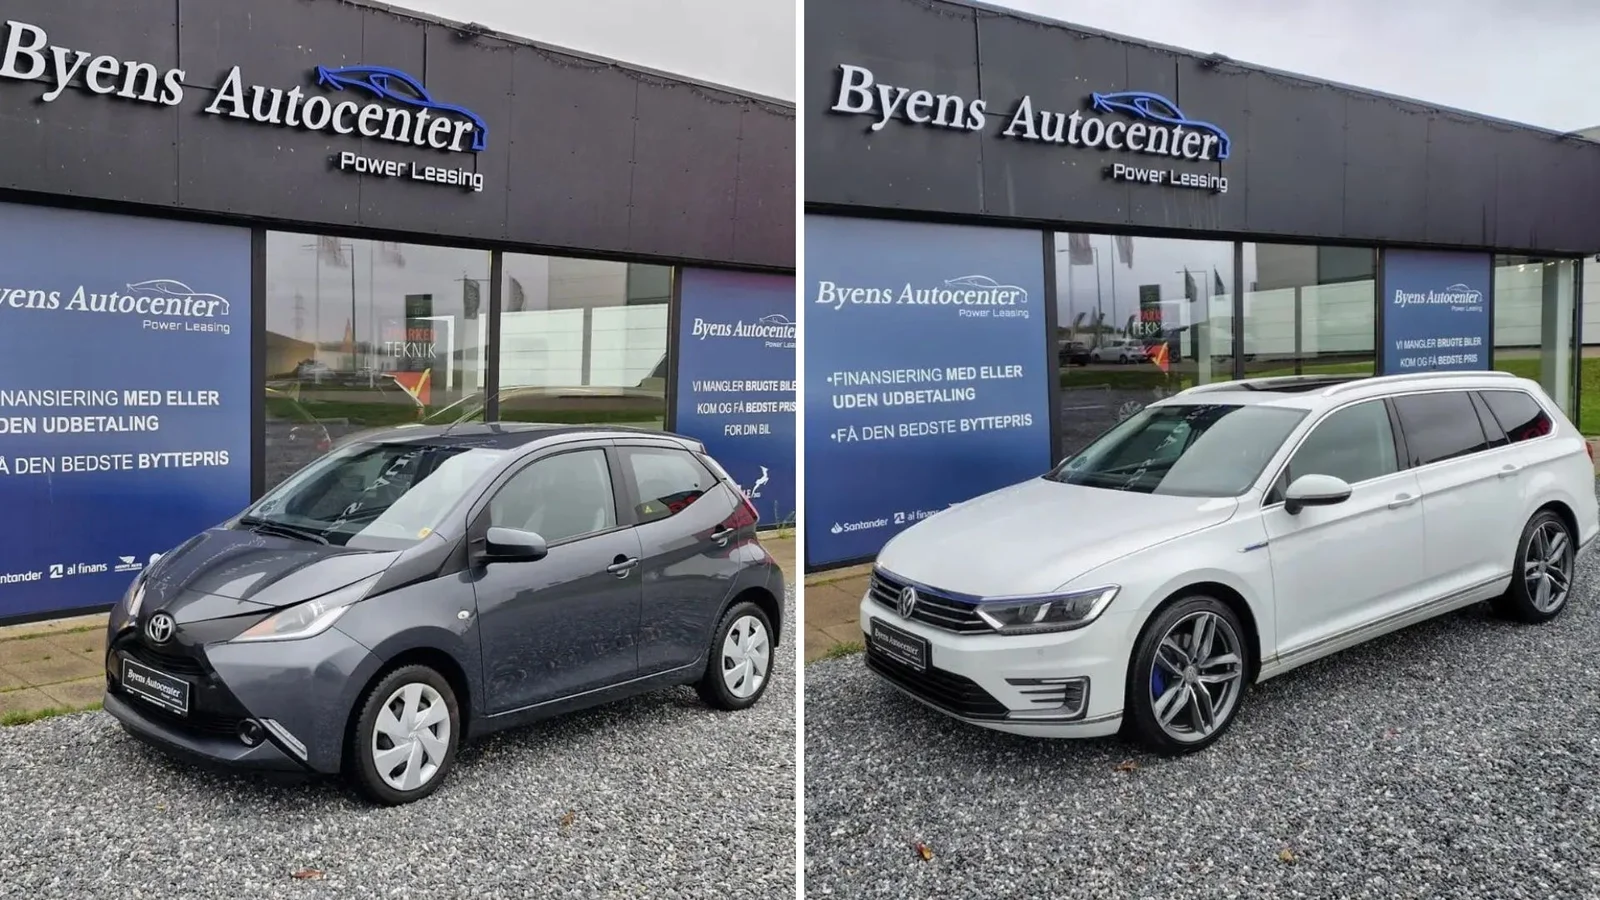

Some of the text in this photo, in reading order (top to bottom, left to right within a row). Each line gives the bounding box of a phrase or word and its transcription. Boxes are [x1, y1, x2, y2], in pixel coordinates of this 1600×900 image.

[0, 20, 474, 152] Byens Autocenter
[831, 64, 1217, 160] Byens Autocenter
[341, 151, 484, 191] Power Leasing
[1113, 163, 1228, 193] Power Leasing
[65, 285, 219, 317] Autocenter
[815, 281, 1020, 310] Byens Autocenter
[1394, 289, 1479, 308] Byens Autocenter
[958, 308, 1029, 319] Power Leasing
[143, 319, 230, 334] Power Leasing
[692, 318, 732, 340] Byens
[385, 341, 437, 358] TEKNIK
[1395, 337, 1482, 350] VI MANGLER BRUGTE BILER
[1400, 357, 1416, 367] KOM
[1417, 357, 1427, 367] OG
[1438, 354, 1463, 365] BEDSTE
[1463, 354, 1478, 363] PRIS
[946, 367, 976, 381] MED
[980, 365, 1023, 379] ELLER
[692, 380, 701, 392] VI
[703, 380, 744, 392] MANGLER
[745, 380, 778, 391] BRUGTE
[1, 390, 220, 406] NANSIERING MED ELLER
[832, 387, 976, 409] UDEN UDBETALING
[697, 401, 796, 414] KOM OG FÅ BEDSTE PRIS
[43, 415, 159, 433] UDBETALING
[725, 424, 771, 436] FOR DIN BIL
[862, 425, 894, 441] DEN
[899, 420, 956, 437] BEDSTE
[960, 414, 1033, 432] BYTTEPRIS
[15, 457, 55, 475] DEN
[61, 454, 133, 472] BEDSTE
[138, 450, 229, 469] BYTTEPRIS
[907, 511, 914, 521] al
[843, 518, 889, 532] Santander
[67, 564, 76, 575] al
[78, 562, 108, 574] finans
[145, 676, 181, 698] Autocenter
